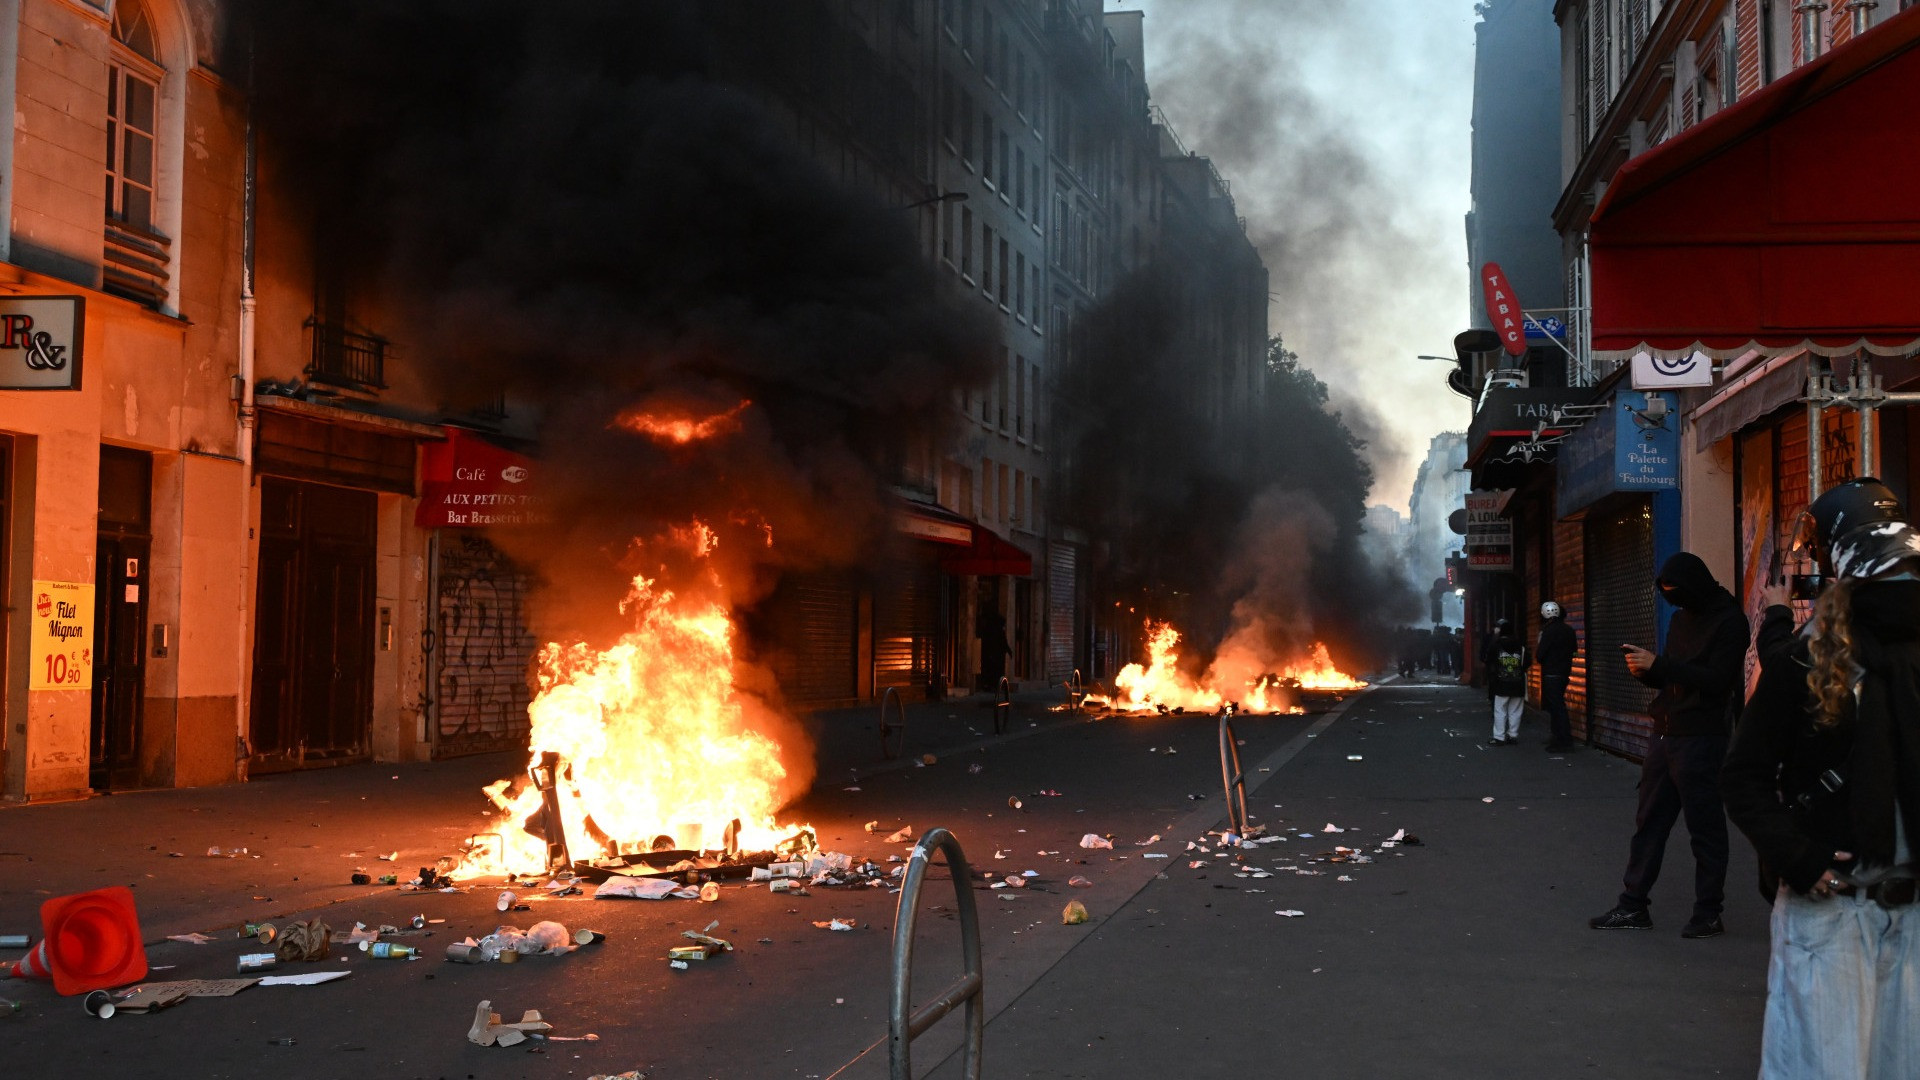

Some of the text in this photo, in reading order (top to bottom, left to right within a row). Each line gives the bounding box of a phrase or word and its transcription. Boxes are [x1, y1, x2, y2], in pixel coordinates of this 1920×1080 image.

[1488, 275, 1518, 342] TABAC
[1513, 402, 1574, 418] TABAC
[1637, 443, 1657, 454] La
[1627, 453, 1669, 464] Palette
[456, 467, 486, 481] Café
[1640, 464, 1654, 473] du
[1618, 472, 1676, 486] Faubourg
[443, 493, 470, 505] AUX
[473, 493, 516, 506] PETITS
[447, 510, 467, 523] Bar
[471, 511, 522, 523] Brasserie
[1478, 512, 1511, 523] LOU
[56, 601, 76, 619] Filet
[48, 620, 83, 642] Mignon
[45, 653, 67, 684] 10
[67, 669, 81, 684] 90
